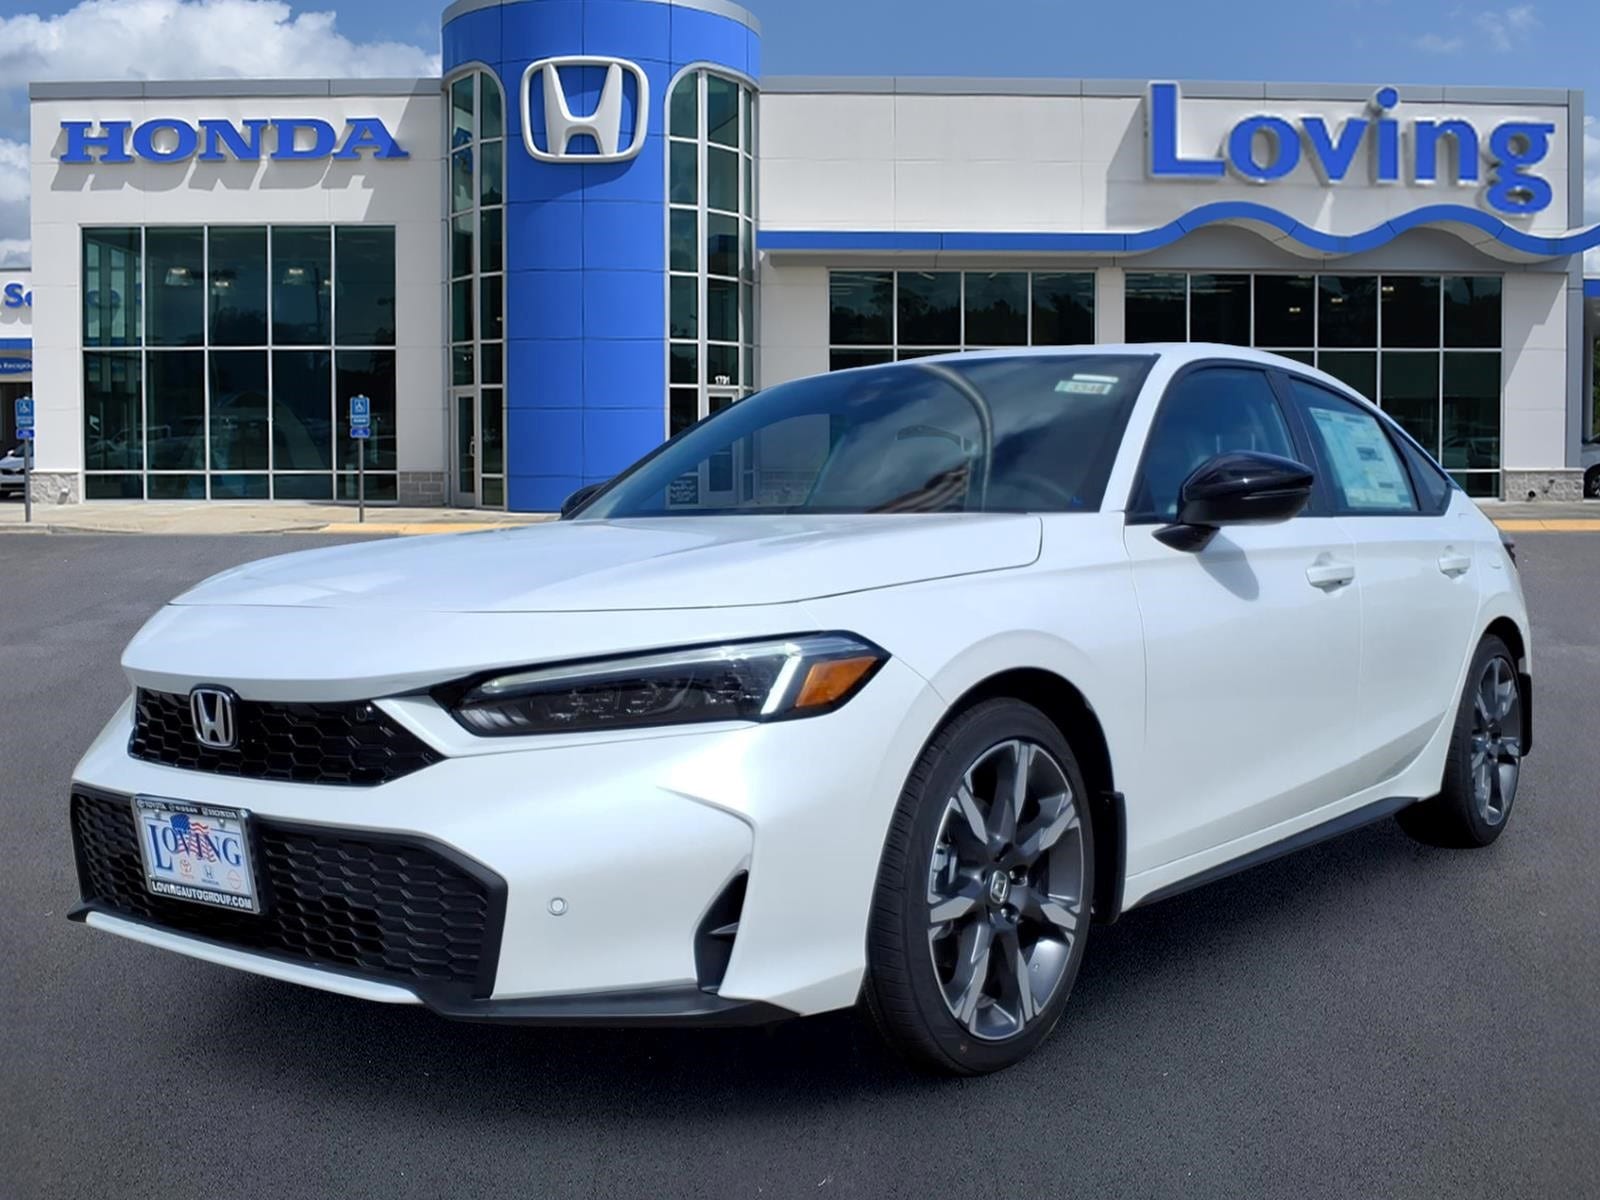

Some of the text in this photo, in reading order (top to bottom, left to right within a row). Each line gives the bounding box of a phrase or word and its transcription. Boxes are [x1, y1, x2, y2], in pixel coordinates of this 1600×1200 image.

[60, 117, 410, 164] HONDA
[1149, 82, 1555, 215] Loving
[148, 824, 241, 871] LOVING
[151, 881, 252, 909] LOVINGAUTOGROUP.COM
